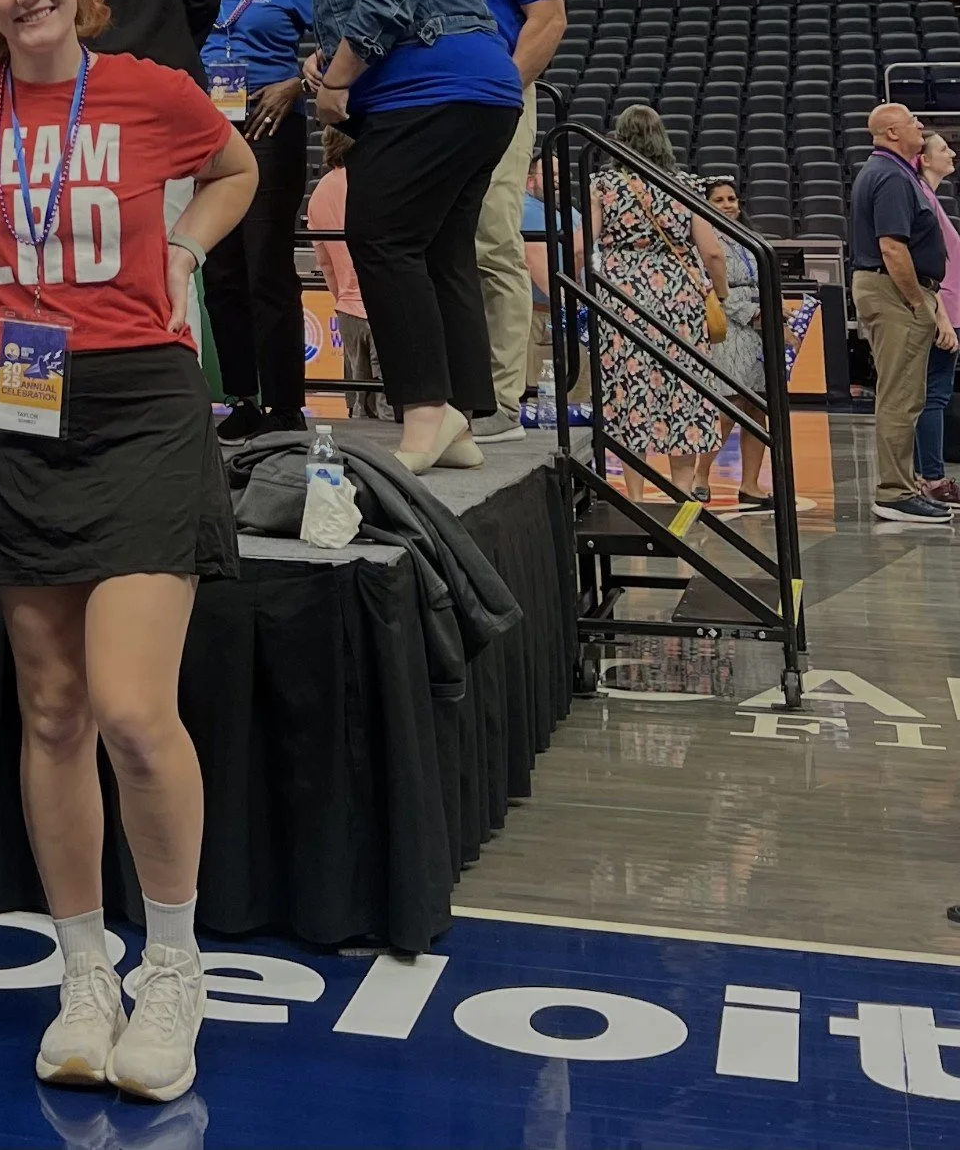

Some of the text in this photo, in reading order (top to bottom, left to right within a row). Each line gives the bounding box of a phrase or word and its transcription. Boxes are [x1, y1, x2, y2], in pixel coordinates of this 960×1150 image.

[3, 361, 22, 374] 20
[1, 385, 57, 401] CELEBRATION
[21, 380, 56, 393] ANNUAL
